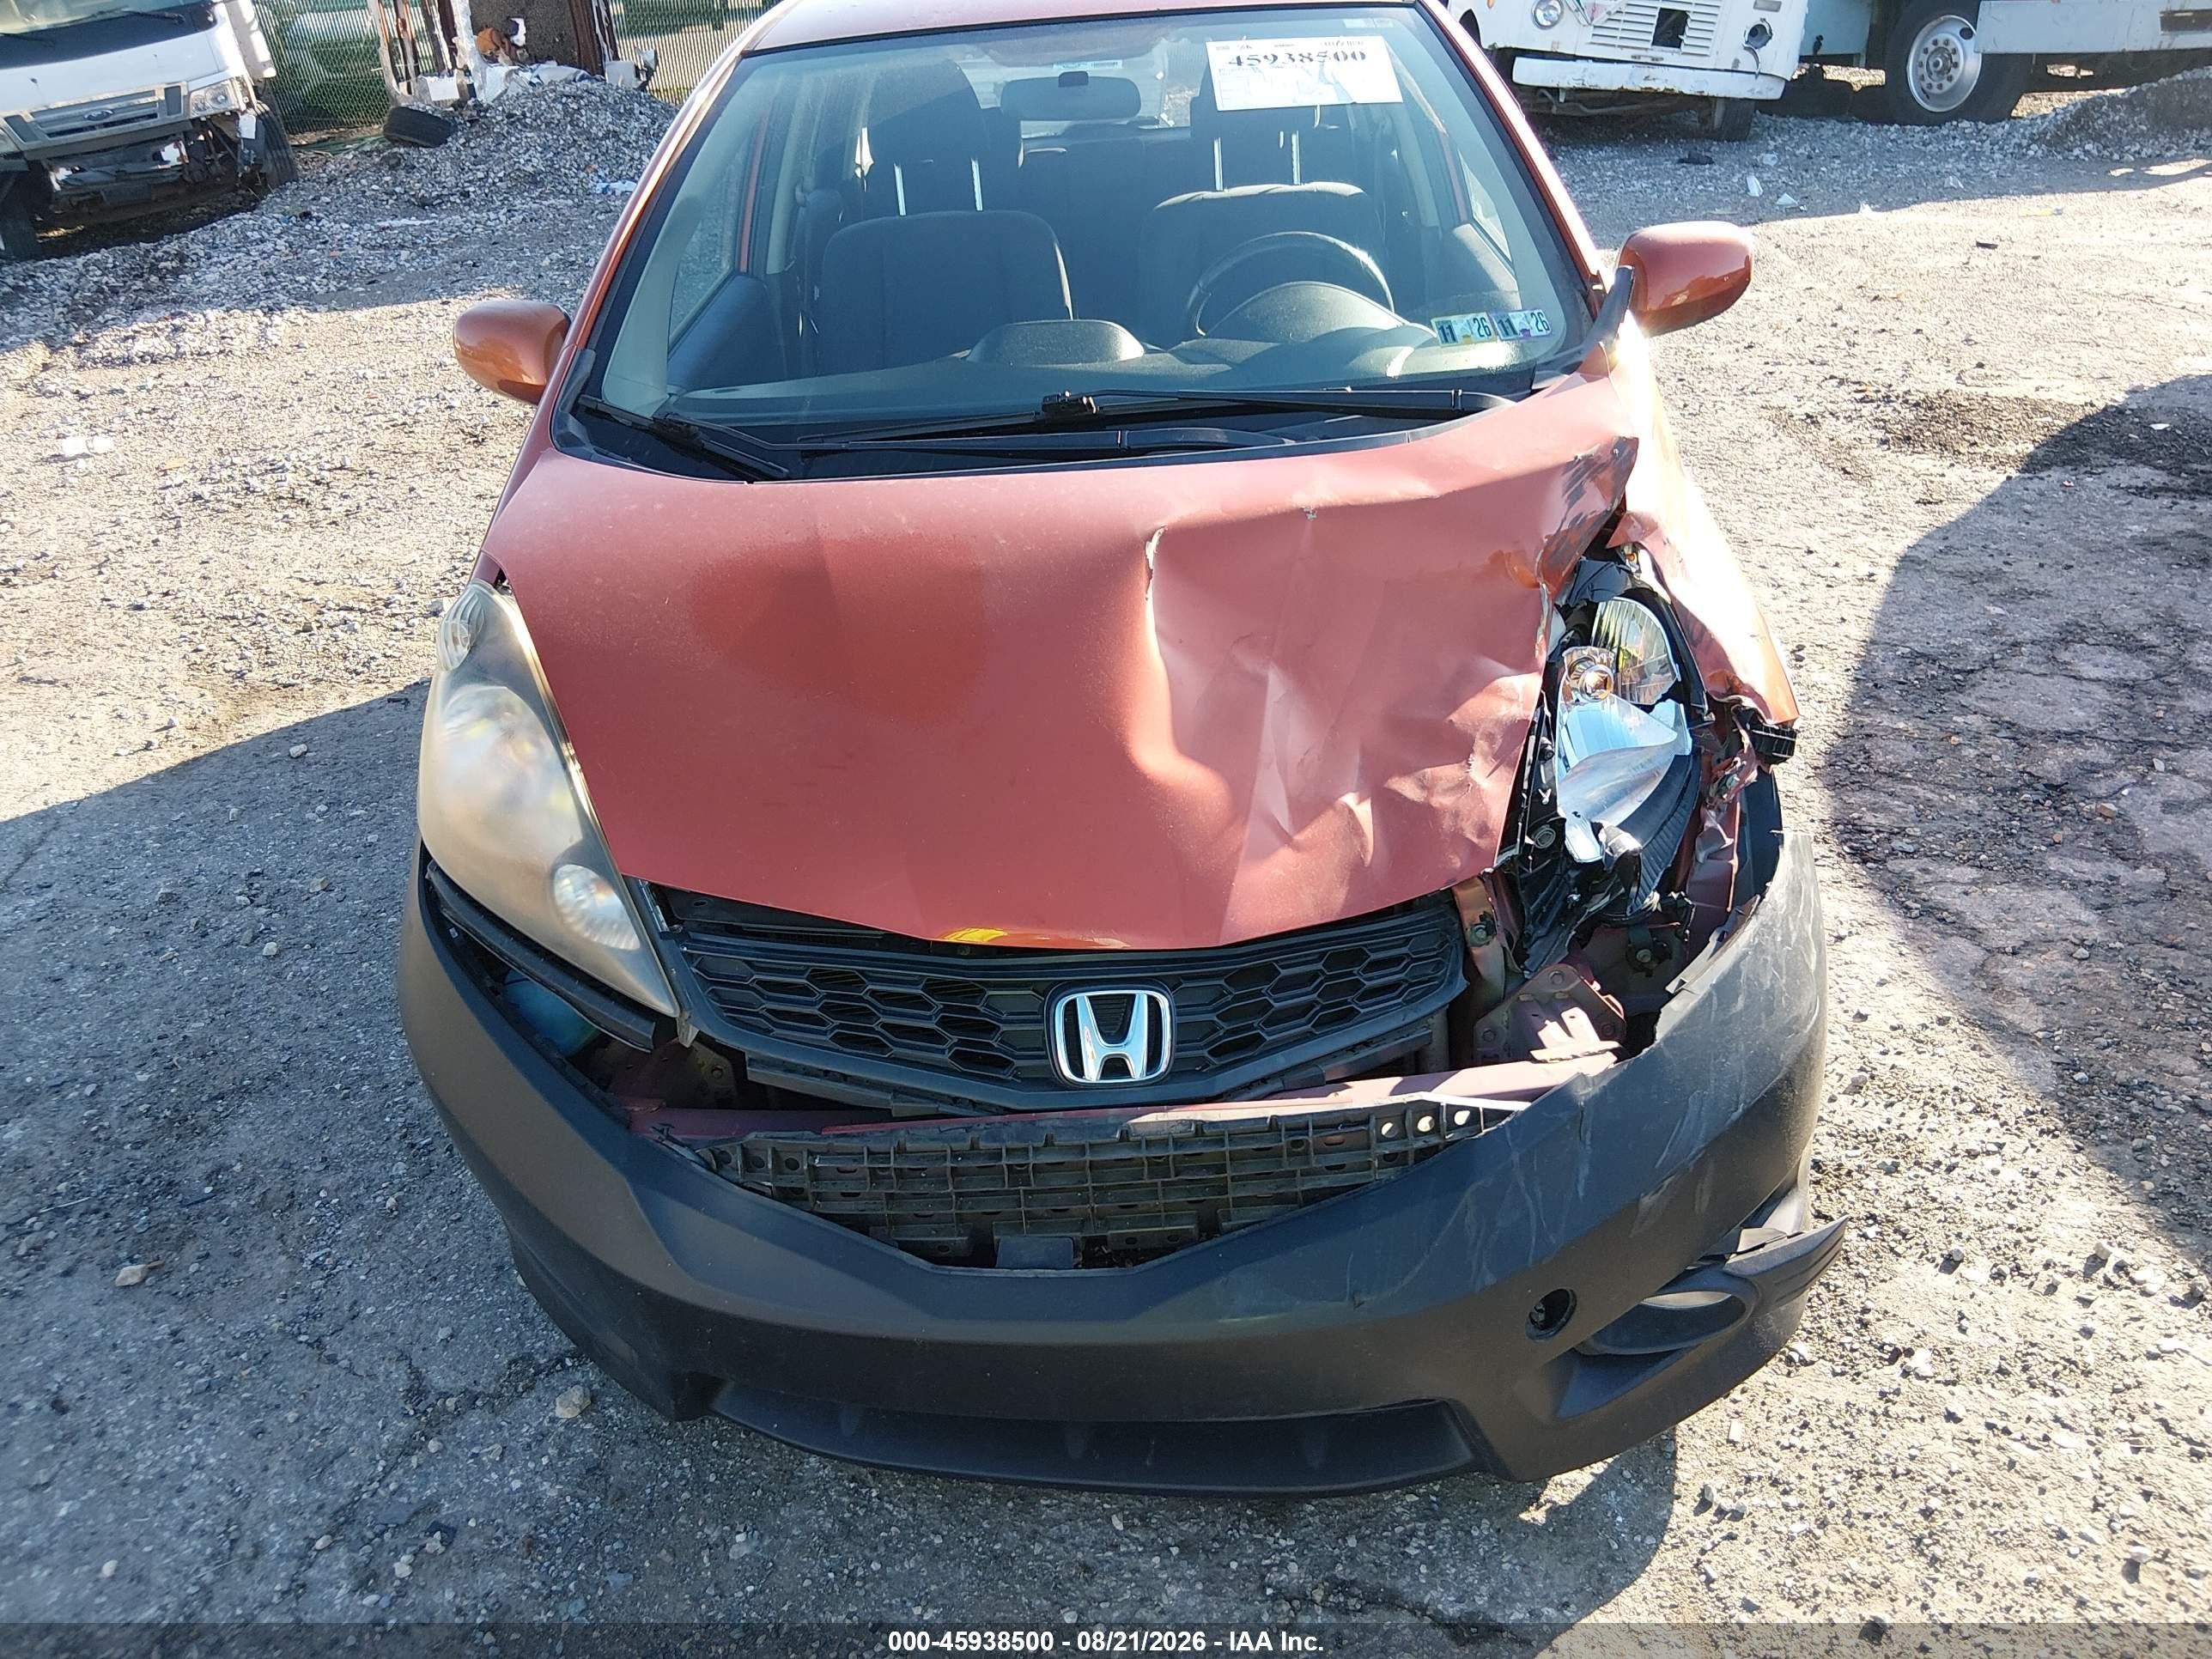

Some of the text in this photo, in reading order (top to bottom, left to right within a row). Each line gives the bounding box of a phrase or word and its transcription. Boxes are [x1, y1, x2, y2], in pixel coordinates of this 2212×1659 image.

[1228, 50, 1367, 67] 45938500
[1437, 317, 1492, 343] 11 26
[1497, 311, 1550, 336] 11 26
